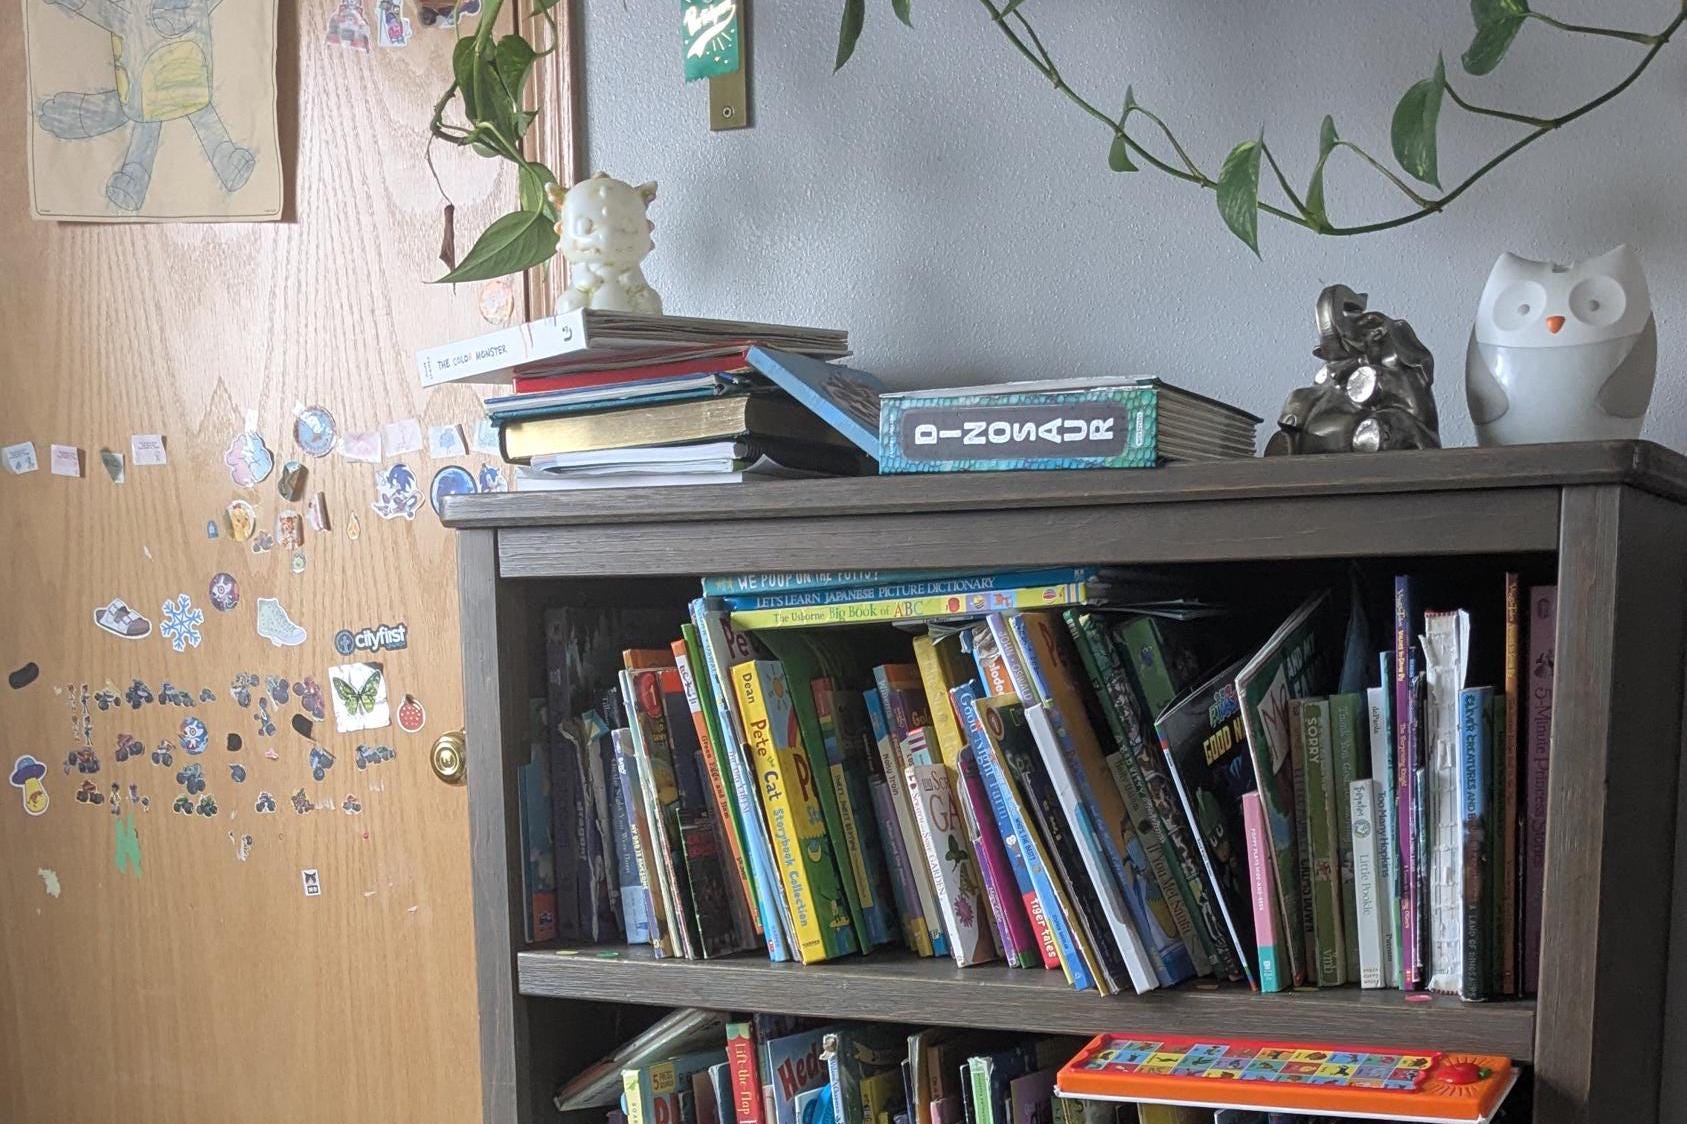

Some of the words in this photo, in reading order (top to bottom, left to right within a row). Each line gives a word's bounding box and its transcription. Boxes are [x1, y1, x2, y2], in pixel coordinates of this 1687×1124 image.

[437, 359, 451, 369] THE
[475, 344, 507, 360] MONSTER
[914, 417, 1114, 445] DINOSAUR
[738, 576, 758, 589] WE
[760, 574, 793, 588] POOP
[756, 594, 781, 608] LET'S
[781, 592, 819, 606] LEARN
[824, 589, 874, 604] JAPANESE
[878, 584, 924, 599] PICTURE
[927, 577, 996, 595] DICTIONARY
[774, 612, 789, 623] The
[792, 608, 825, 622] Usborne
[829, 606, 846, 622] Big
[848, 604, 877, 619] Book
[879, 603, 890, 616] of
[893, 601, 923, 617] ABC
[355, 625, 405, 650] cityfirst
[997, 631, 1014, 657] JOHN
[1011, 664, 1032, 700] OSWALD
[742, 672, 755, 704] Dean
[1339, 706, 1349, 736] Thank
[1372, 706, 1380, 734] dePaola
[1465, 695, 1477, 731] CLEVER
[1534, 687, 1551, 755] 5-Minute
[959, 693, 981, 732] Good
[975, 737, 993, 776] Night
[990, 783, 1008, 819] Farm
[1307, 717, 1319, 764] SORRY
[750, 719, 769, 757] Pete
[764, 770, 783, 801] Cat
[883, 753, 895, 774] Noisy
[889, 775, 899, 797] Train
[1466, 735, 1477, 790] CREATURES
[701, 735, 712, 758] Green
[709, 762, 720, 781] Eggs
[715, 784, 724, 799] and
[720, 801, 730, 819] Ham
[1533, 757, 1550, 818] Princess
[1377, 791, 1386, 808] Too
[1466, 792, 1475, 814] AND
[1250, 828, 1258, 847] POPPY
[1378, 809, 1388, 838] Many
[1146, 843, 1161, 852] If
[1380, 838, 1390, 877] Hopkins
[773, 808, 795, 865] Storybook
[789, 870, 809, 927] Collection
[928, 854, 945, 895] GARDEN
[1153, 855, 1168, 878] You
[1359, 854, 1372, 880] Little
[1161, 879, 1178, 899] Met
[1361, 883, 1373, 915] Pookie
[1171, 901, 1192, 934] Santa
[1304, 898, 1314, 933] DOWN
[733, 1042, 752, 1115] Lift-the-Flap
